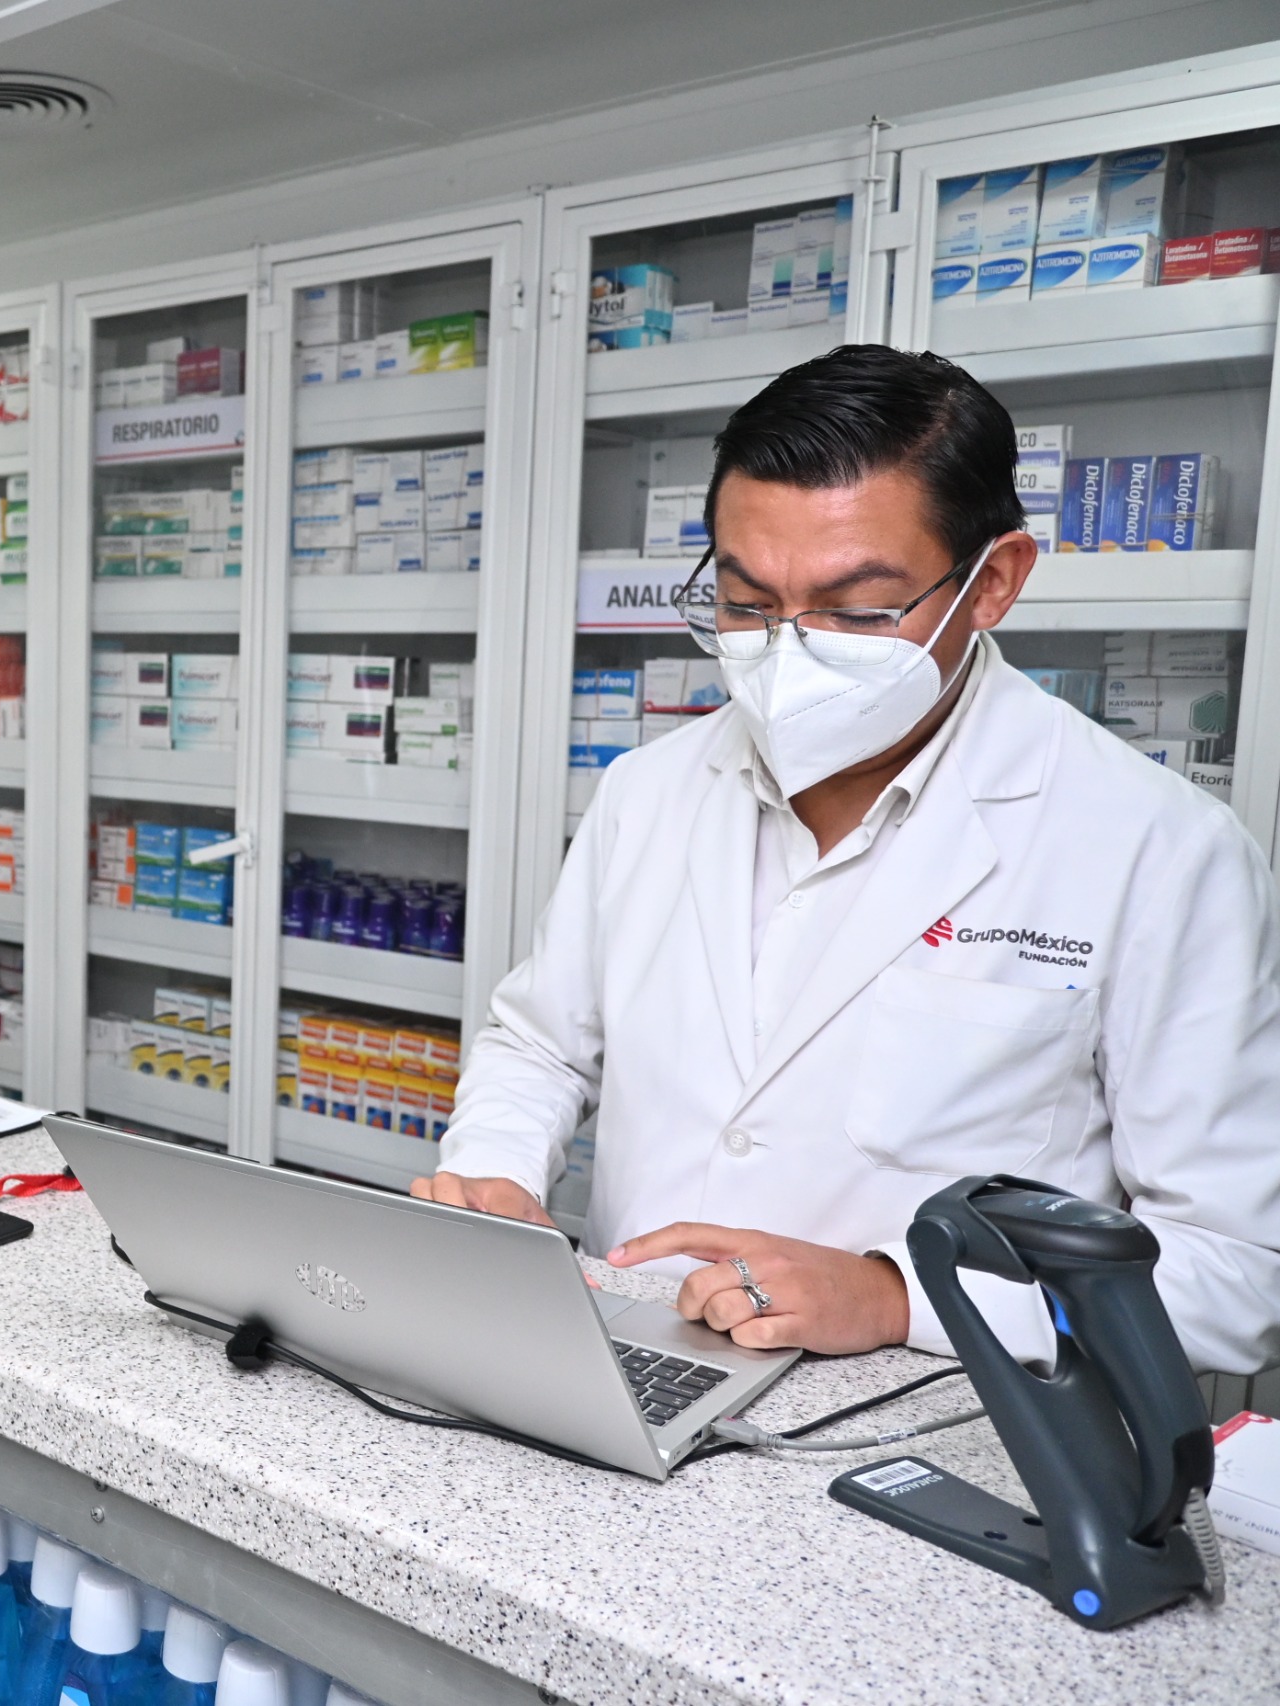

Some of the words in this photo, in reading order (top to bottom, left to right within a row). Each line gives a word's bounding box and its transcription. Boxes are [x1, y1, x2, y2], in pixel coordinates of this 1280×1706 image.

[1214, 235, 1248, 246] Loratadina
[1091, 249, 1141, 263] AZITROMICINA
[1165, 244, 1197, 255] Loratadina
[1214, 243, 1259, 255] Betametasona
[1035, 256, 1083, 270] AZITROMICINA
[1164, 252, 1208, 263] Betametasona
[979, 262, 1025, 277] AZITROMICINA
[111, 413, 219, 444] RESPIRATORIO
[1081, 464, 1099, 547] Diclofenaco
[1125, 462, 1146, 545] Diclofenaco
[1173, 461, 1195, 545] Diclofenaco
[1019, 950, 1087, 968] FUNDACIÓN
